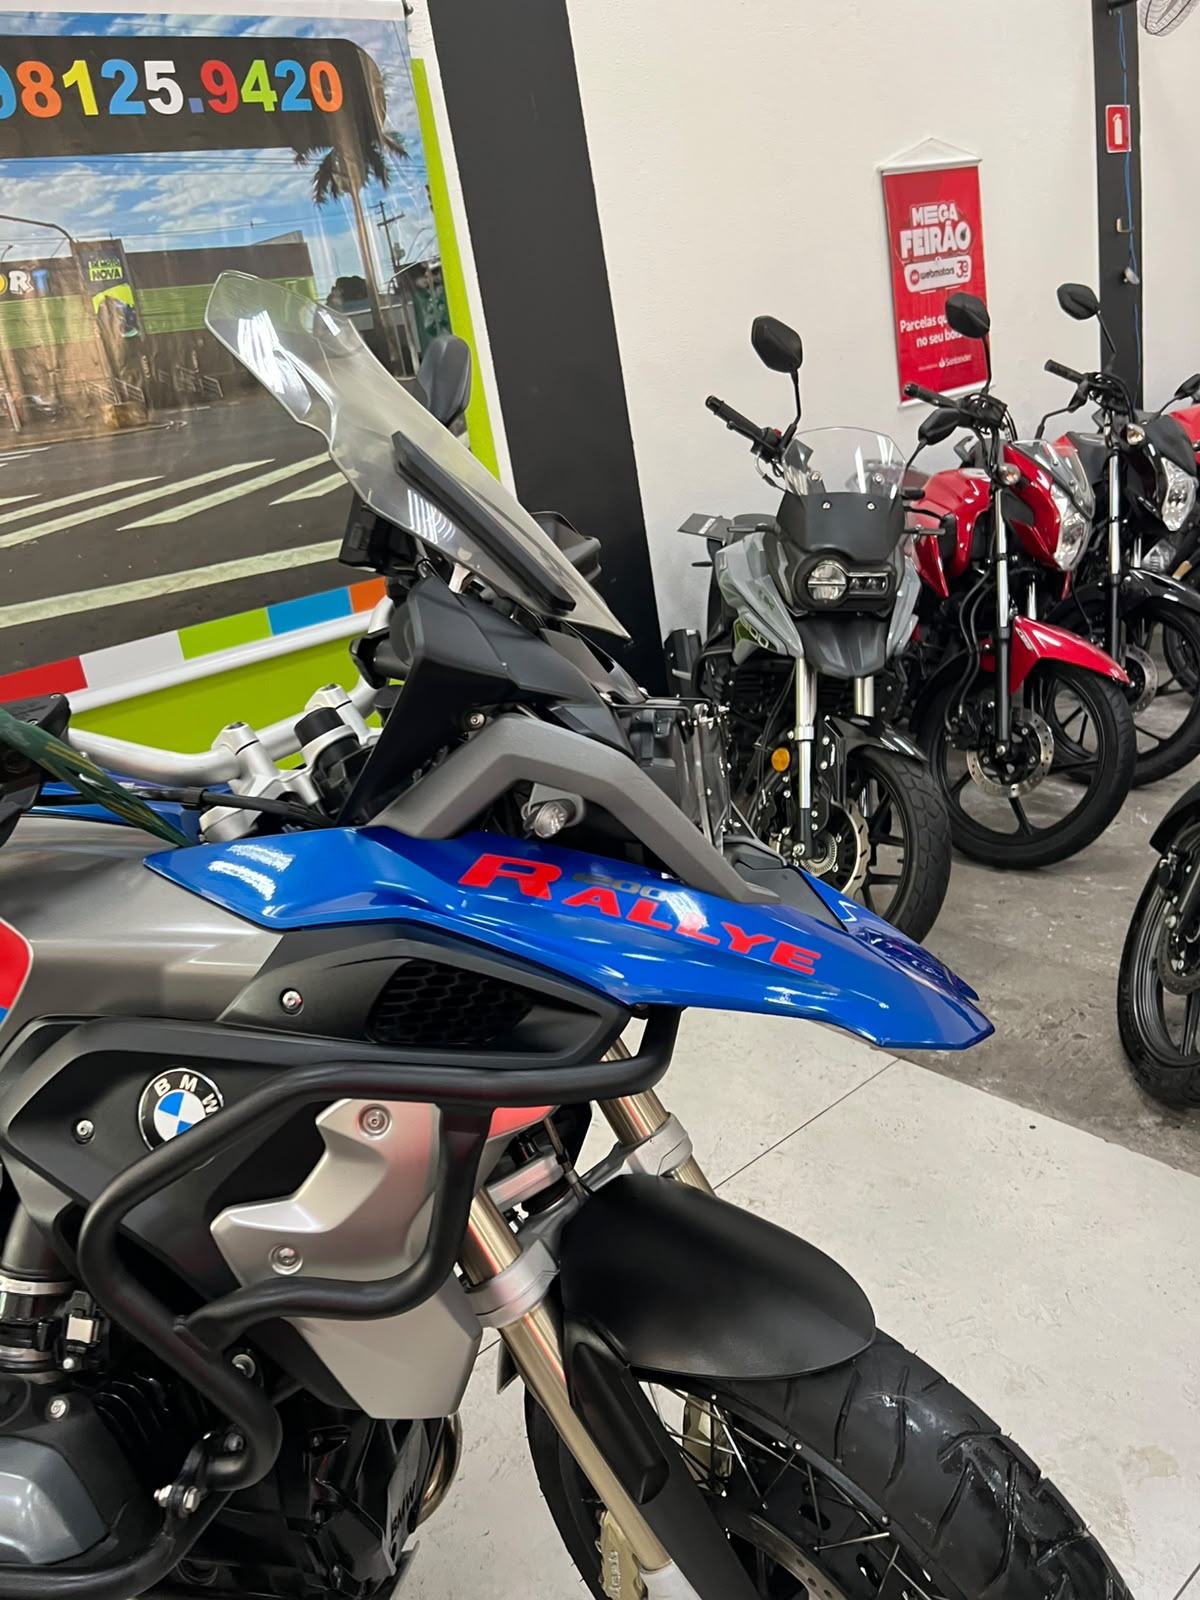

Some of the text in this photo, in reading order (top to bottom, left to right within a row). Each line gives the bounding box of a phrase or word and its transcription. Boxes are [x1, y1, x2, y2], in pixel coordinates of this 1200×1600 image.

[911, 202, 958, 227] MEGA
[900, 220, 971, 259] FEIRÃO
[91, 267, 122, 280] NOVA
[920, 266, 955, 280] webmotors
[900, 315, 936, 333] Parcelas
[916, 336, 928, 348] no
[929, 332, 944, 345] seu
[458, 853, 821, 976] RALLYE
[153, 1074, 219, 1114] BMW
